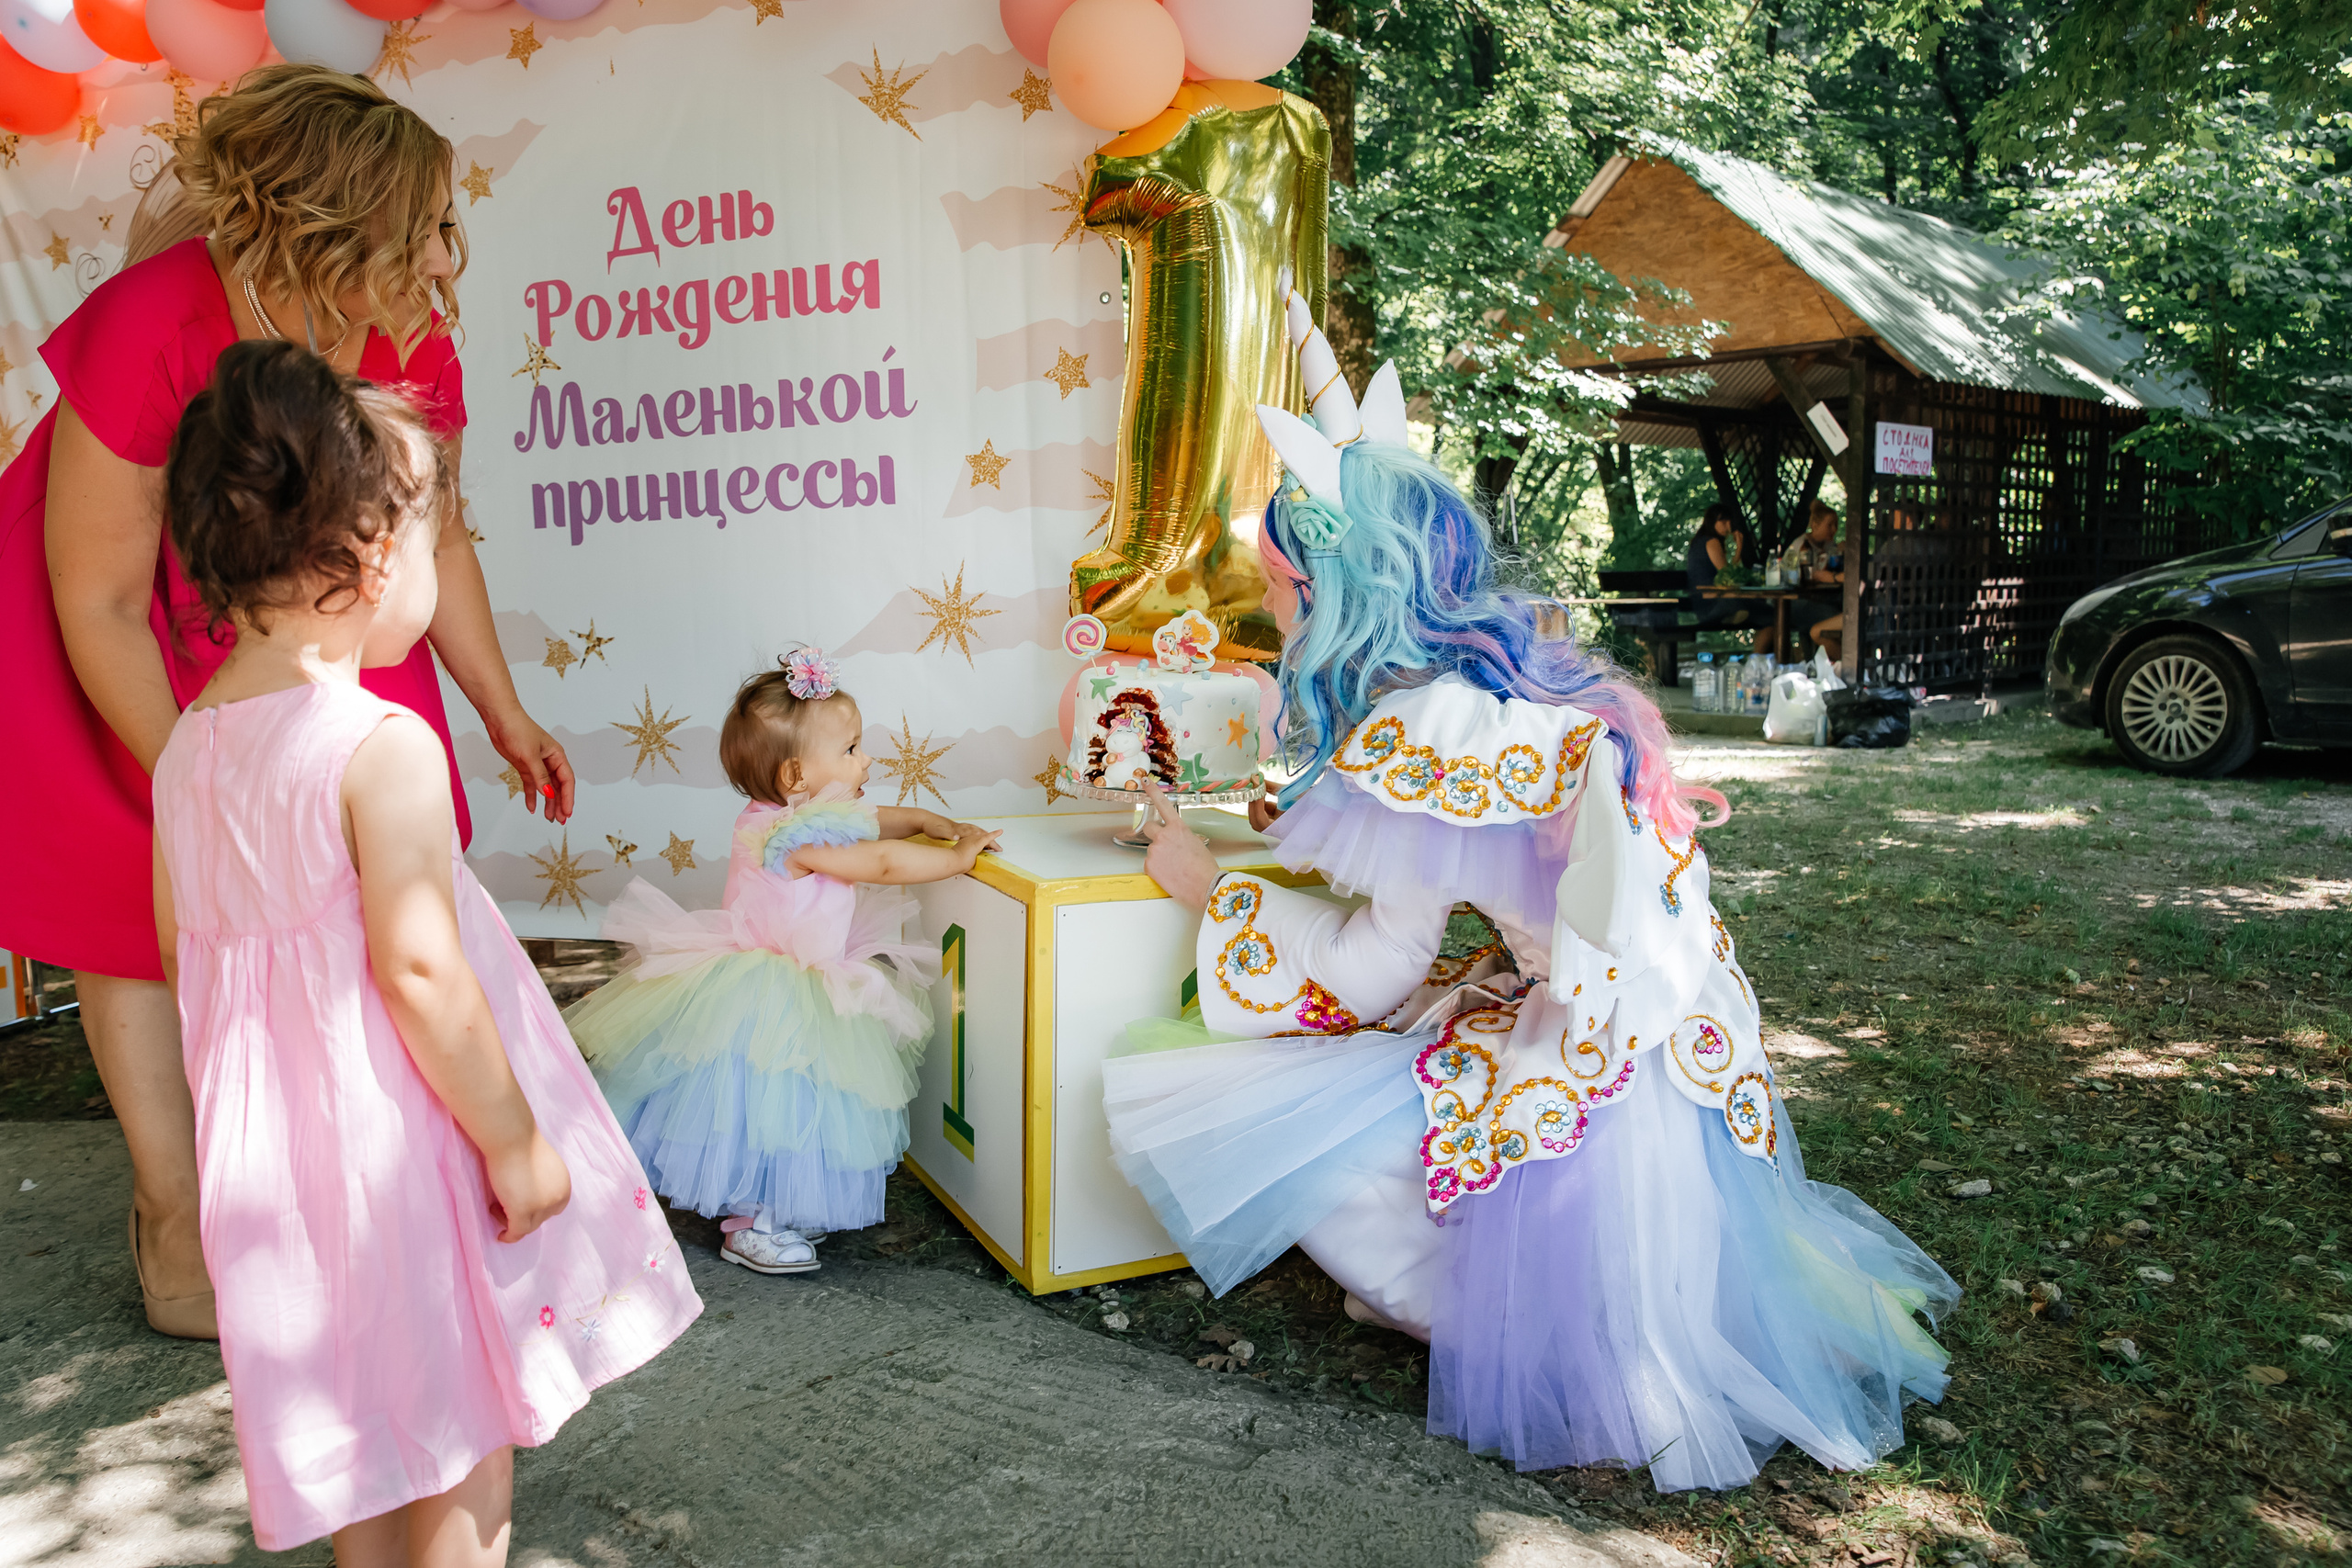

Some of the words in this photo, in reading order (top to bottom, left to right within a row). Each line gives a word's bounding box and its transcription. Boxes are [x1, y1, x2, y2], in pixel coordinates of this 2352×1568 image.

[606, 186, 775, 275] День
[524, 258, 881, 350] Рождения
[514, 345, 919, 453] Маленькой
[532, 455, 897, 546] принцессы
[942, 922, 975, 1164] 1
